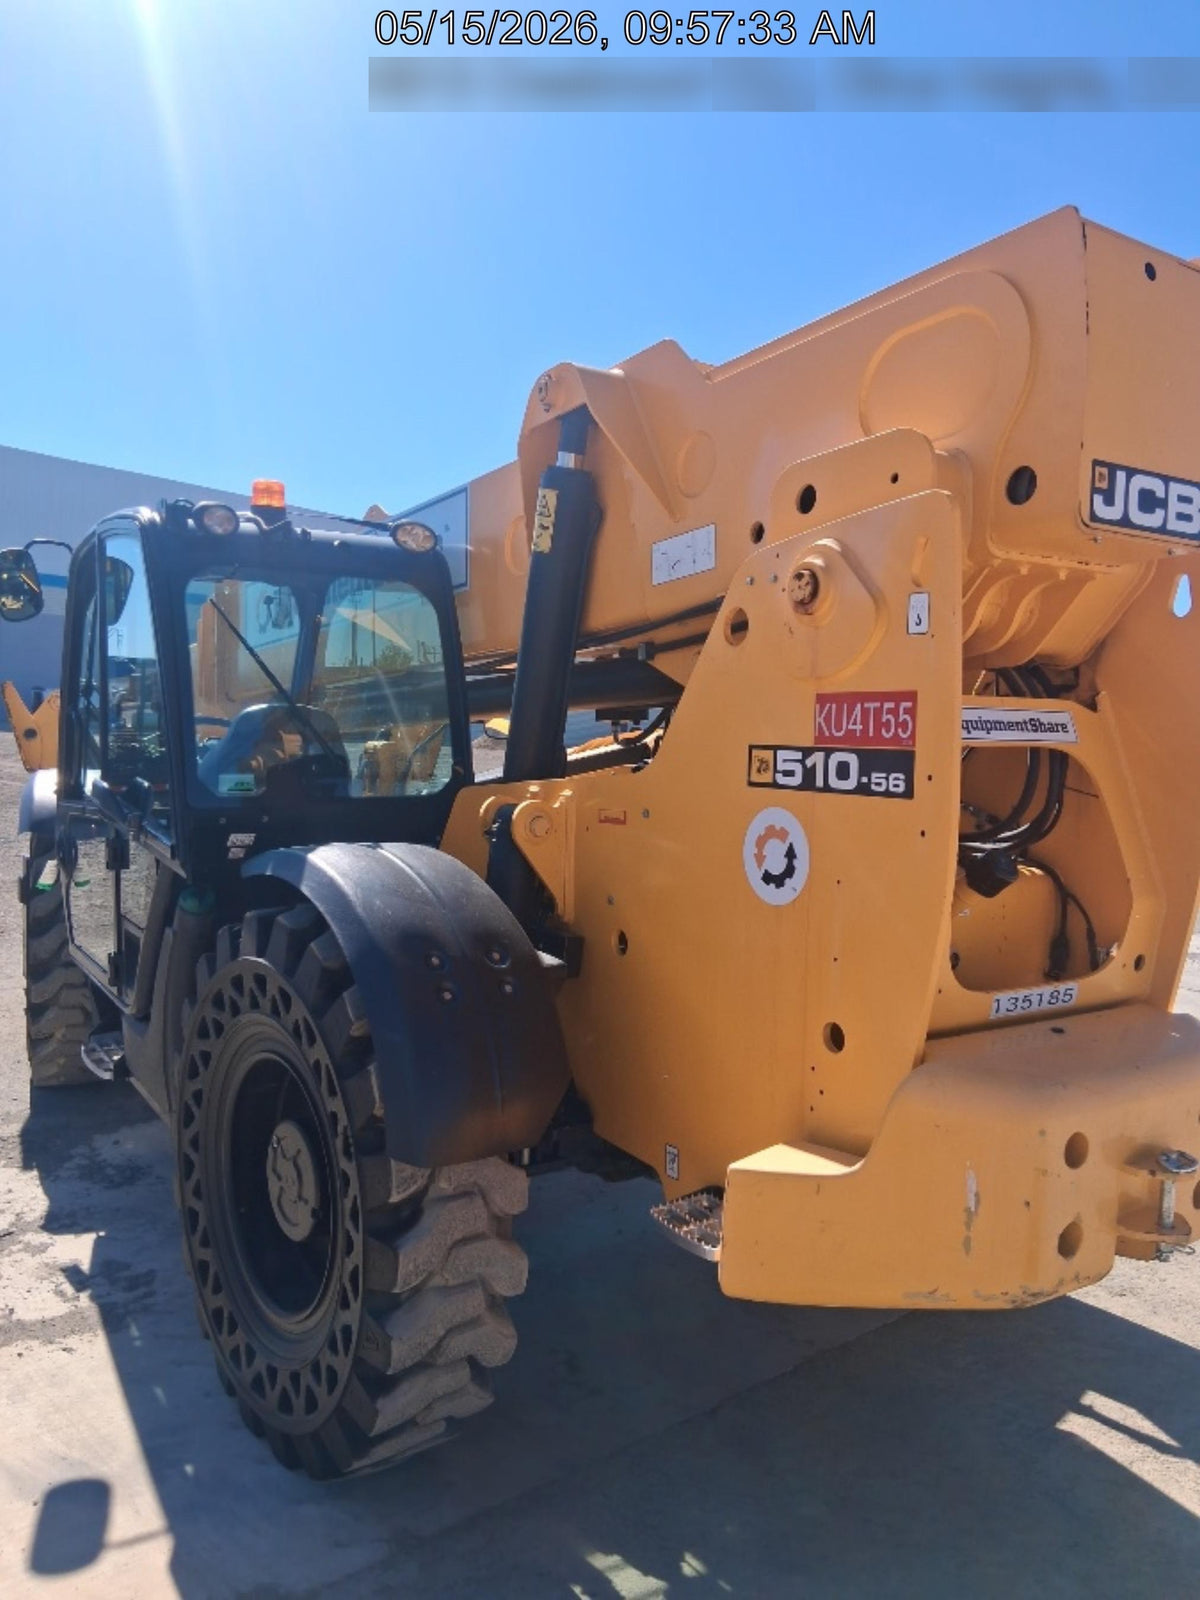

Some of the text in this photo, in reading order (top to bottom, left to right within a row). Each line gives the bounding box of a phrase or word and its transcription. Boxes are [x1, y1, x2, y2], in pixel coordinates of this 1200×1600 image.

[1093, 470, 1200, 534] JCB
[815, 702, 913, 738] KU4T55
[961, 716, 1070, 735] quipmentShare
[993, 987, 1075, 1014] 135185
